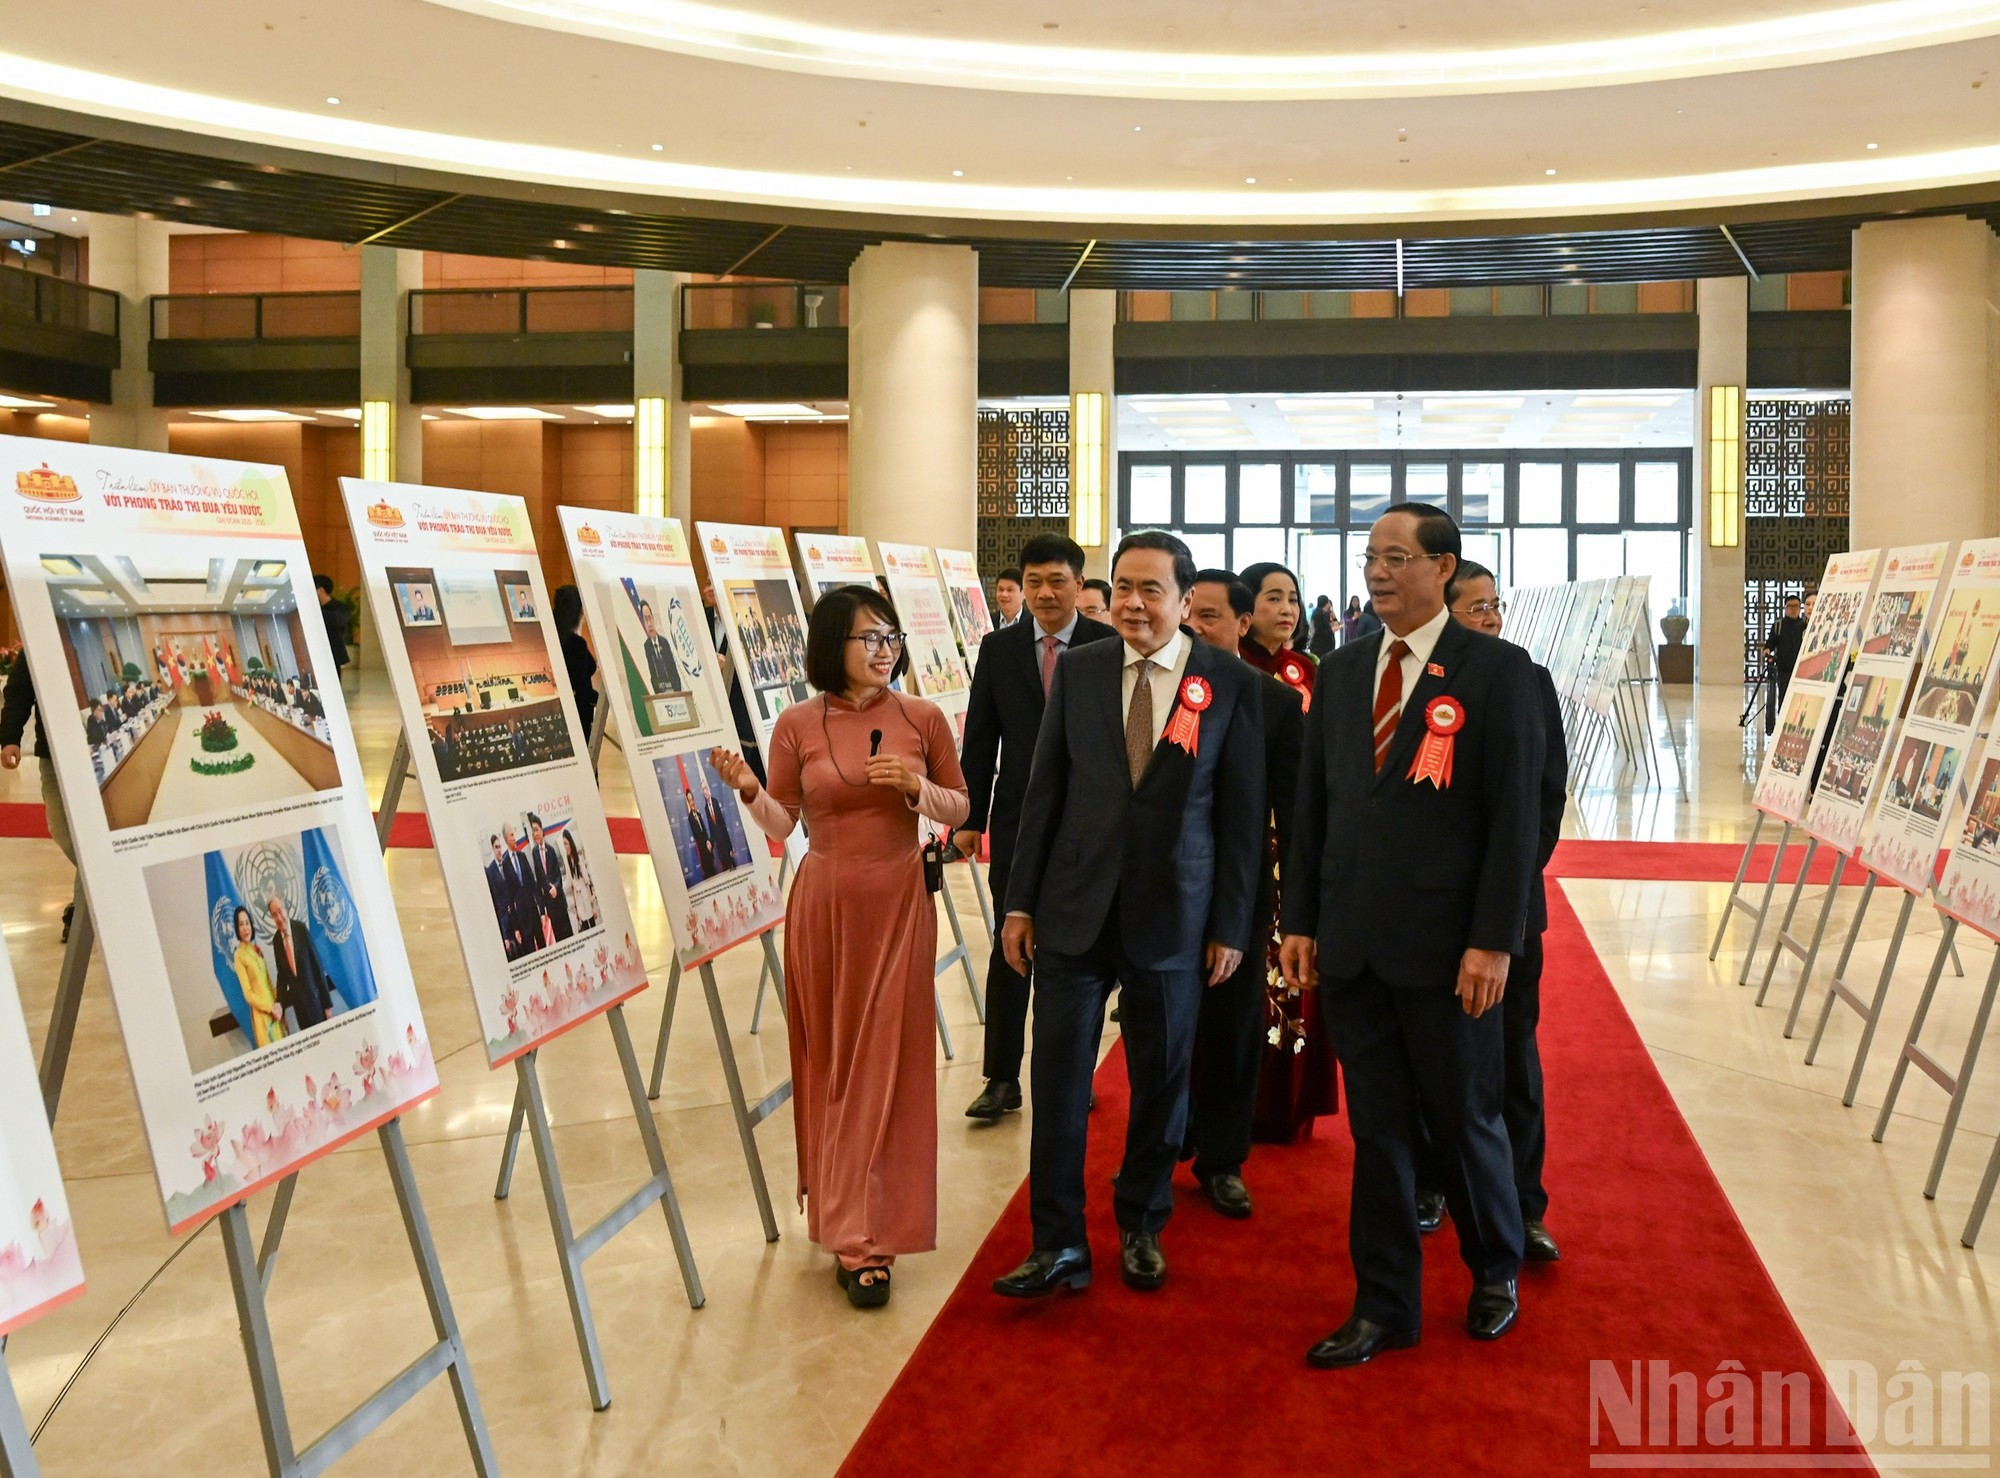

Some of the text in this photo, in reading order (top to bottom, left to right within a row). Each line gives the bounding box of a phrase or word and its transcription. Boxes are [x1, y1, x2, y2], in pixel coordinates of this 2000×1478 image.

[123, 496, 157, 510] PHONG
[158, 497, 184, 511] TRÀO
[184, 500, 201, 513] THI
[221, 501, 238, 515] YÊU
